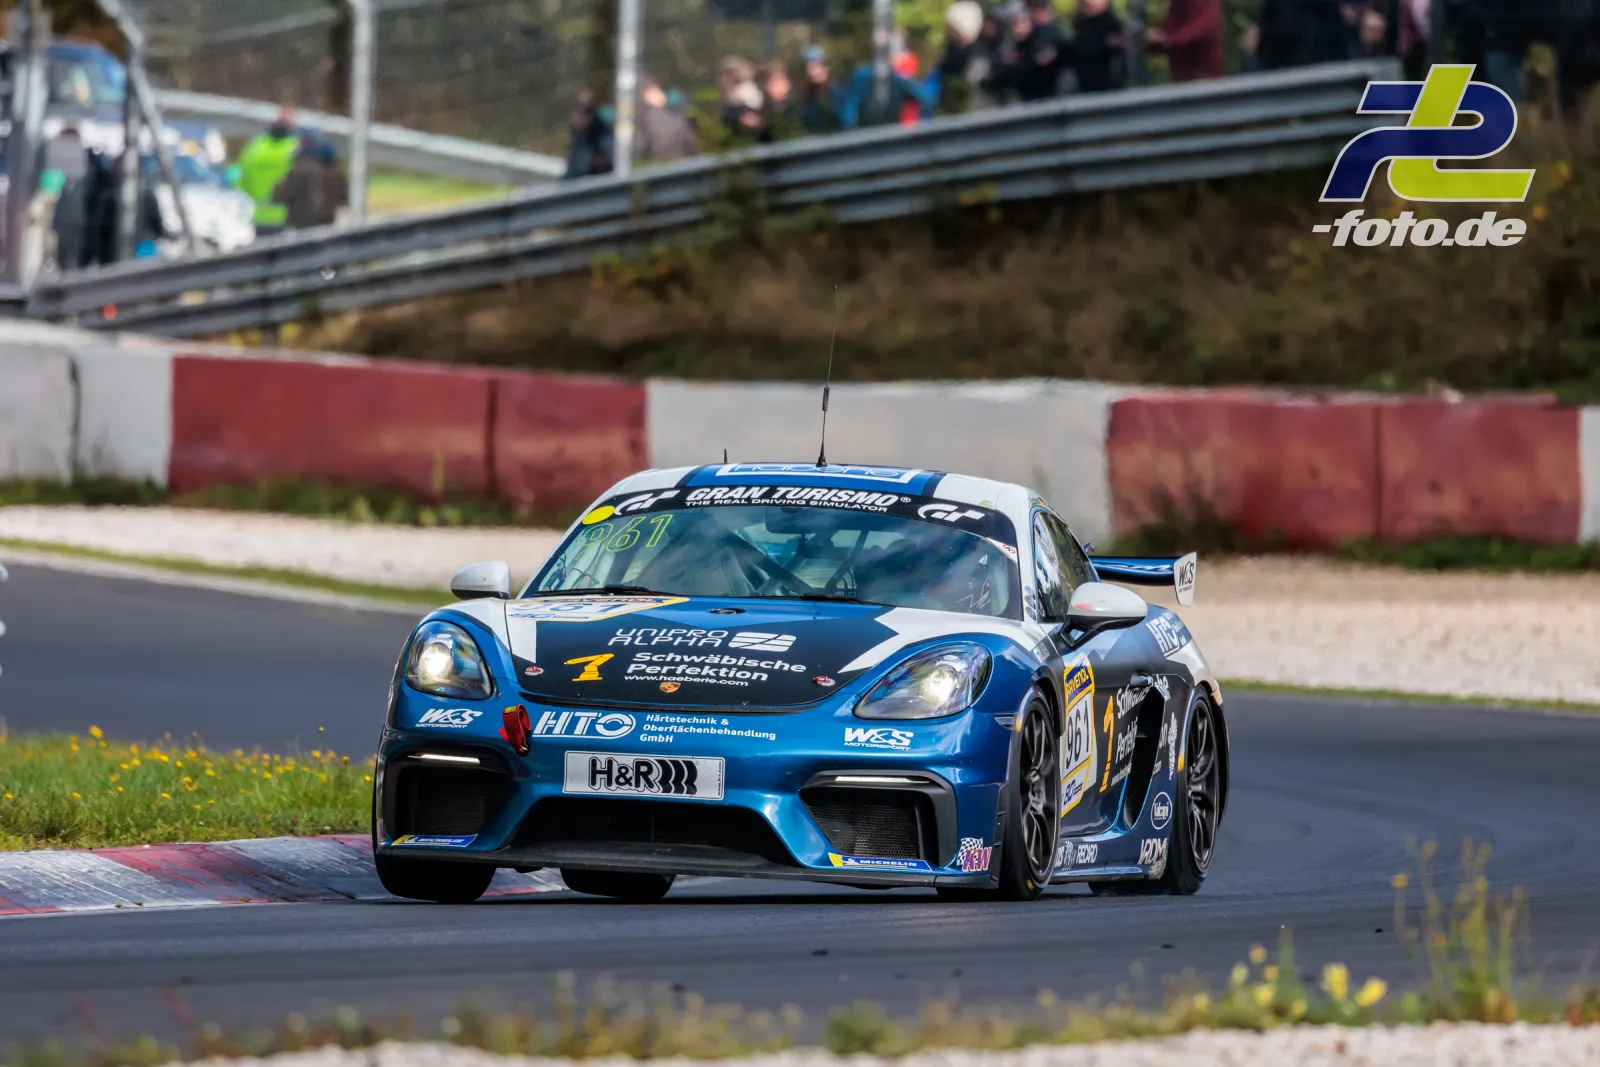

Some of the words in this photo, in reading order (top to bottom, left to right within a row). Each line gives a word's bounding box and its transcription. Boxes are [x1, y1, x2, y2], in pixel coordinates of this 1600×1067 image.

[686, 486, 770, 501] GRAN
[809, 501, 888, 513] SIMULATOR
[576, 514, 674, 561] 961
[607, 636, 724, 648] ALPHA
[615, 628, 729, 639] UNIPRO
[632, 652, 807, 673] Schwäbische
[624, 674, 749, 687] www.haeberle.com
[626, 663, 769, 682] Perfektion
[419, 708, 484, 725] W&S
[645, 714, 718, 725] Härtetechnik
[720, 718, 730, 726] &
[531, 711, 637, 740] HTO
[642, 724, 777, 741] Oberflächenbehandlung
[639, 733, 675, 744] GmbH
[844, 727, 915, 746] W&S
[1065, 699, 1091, 770] 961
[843, 742, 912, 751] MOTORSPORT
[589, 756, 658, 793] H&R
[859, 859, 918, 868] MICHELIN
[961, 847, 992, 872] KW
